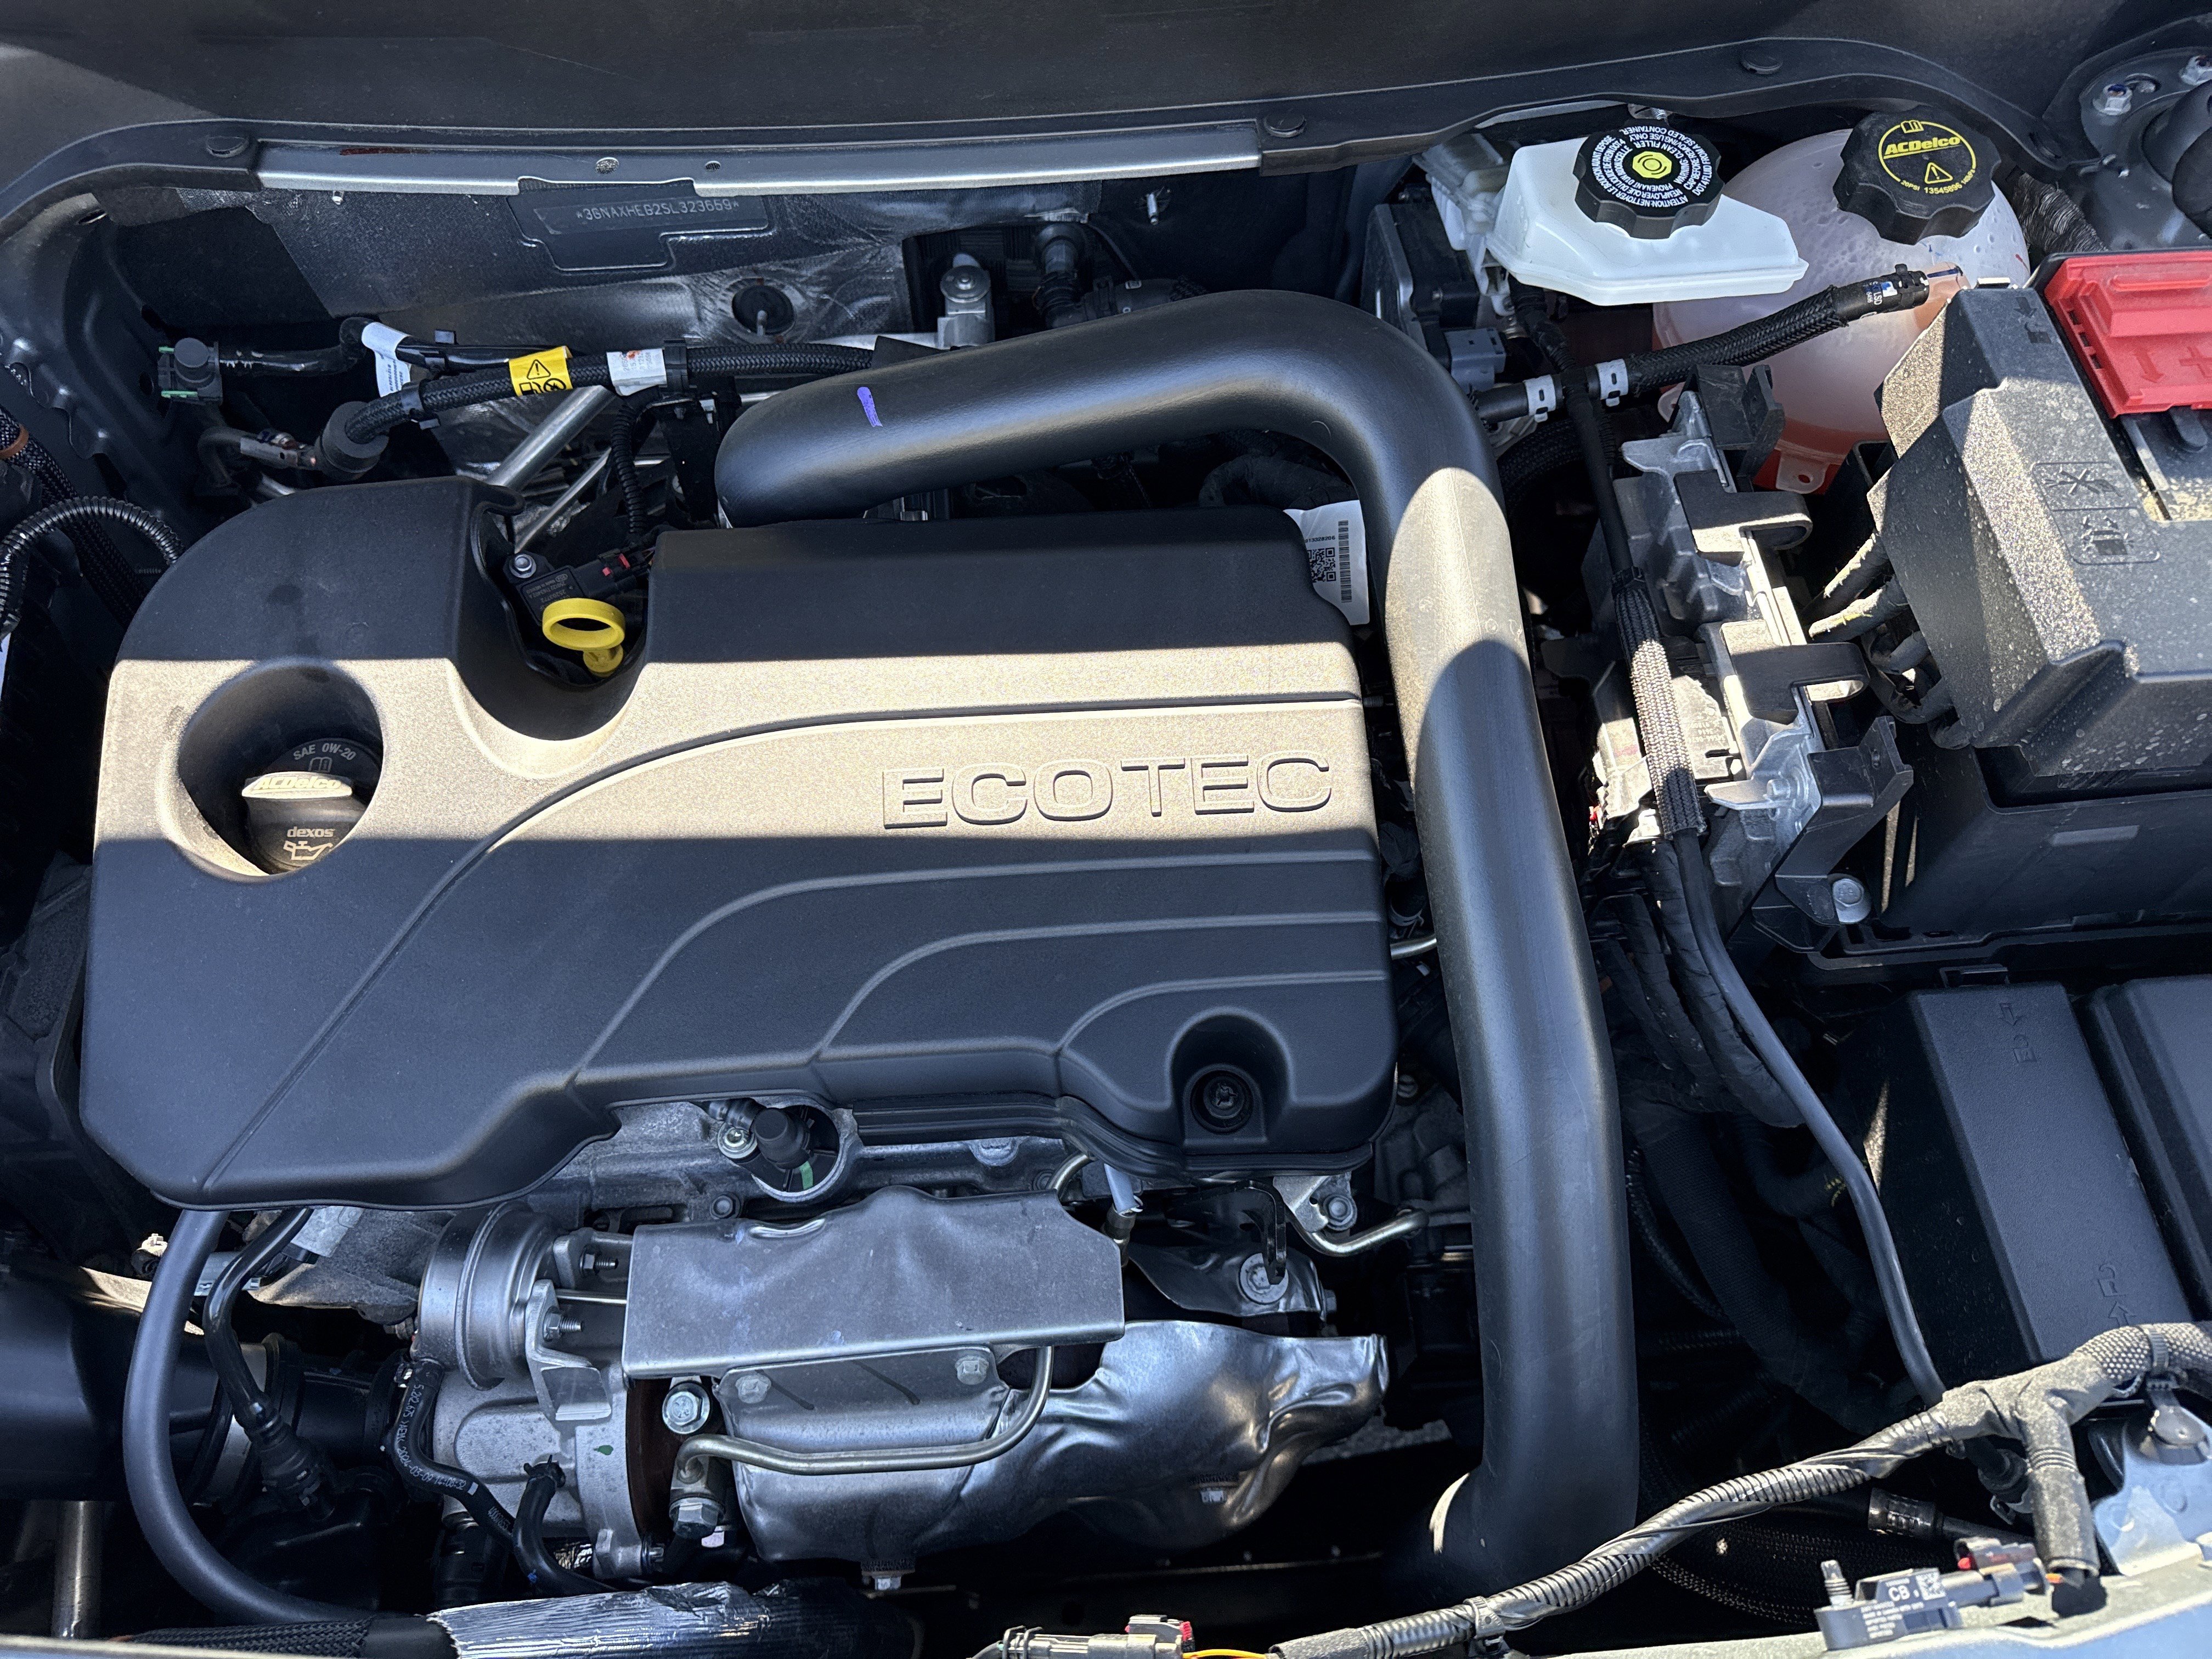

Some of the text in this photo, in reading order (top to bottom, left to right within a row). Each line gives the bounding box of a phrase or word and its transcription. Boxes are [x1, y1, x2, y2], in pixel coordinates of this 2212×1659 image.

[1633, 140, 1661, 148] FILLER
[1667, 129, 1696, 146] SEALED
[1884, 137, 1961, 155] ACDelco
[1661, 142, 1684, 159] CLEAN
[1695, 148, 1711, 165] FROM
[1629, 133, 1701, 190] CAP BEFORE REMOVING USE ONLY
[1606, 186, 1619, 195] LE
[1626, 187, 1642, 197] QUE
[1633, 182, 1674, 191] PROVENANT
[293, 743, 357, 761] SAE 0W-20
[254, 776, 342, 790] ACDelco
[882, 751, 1331, 829] ECOTEC
[287, 826, 335, 838] dexos
